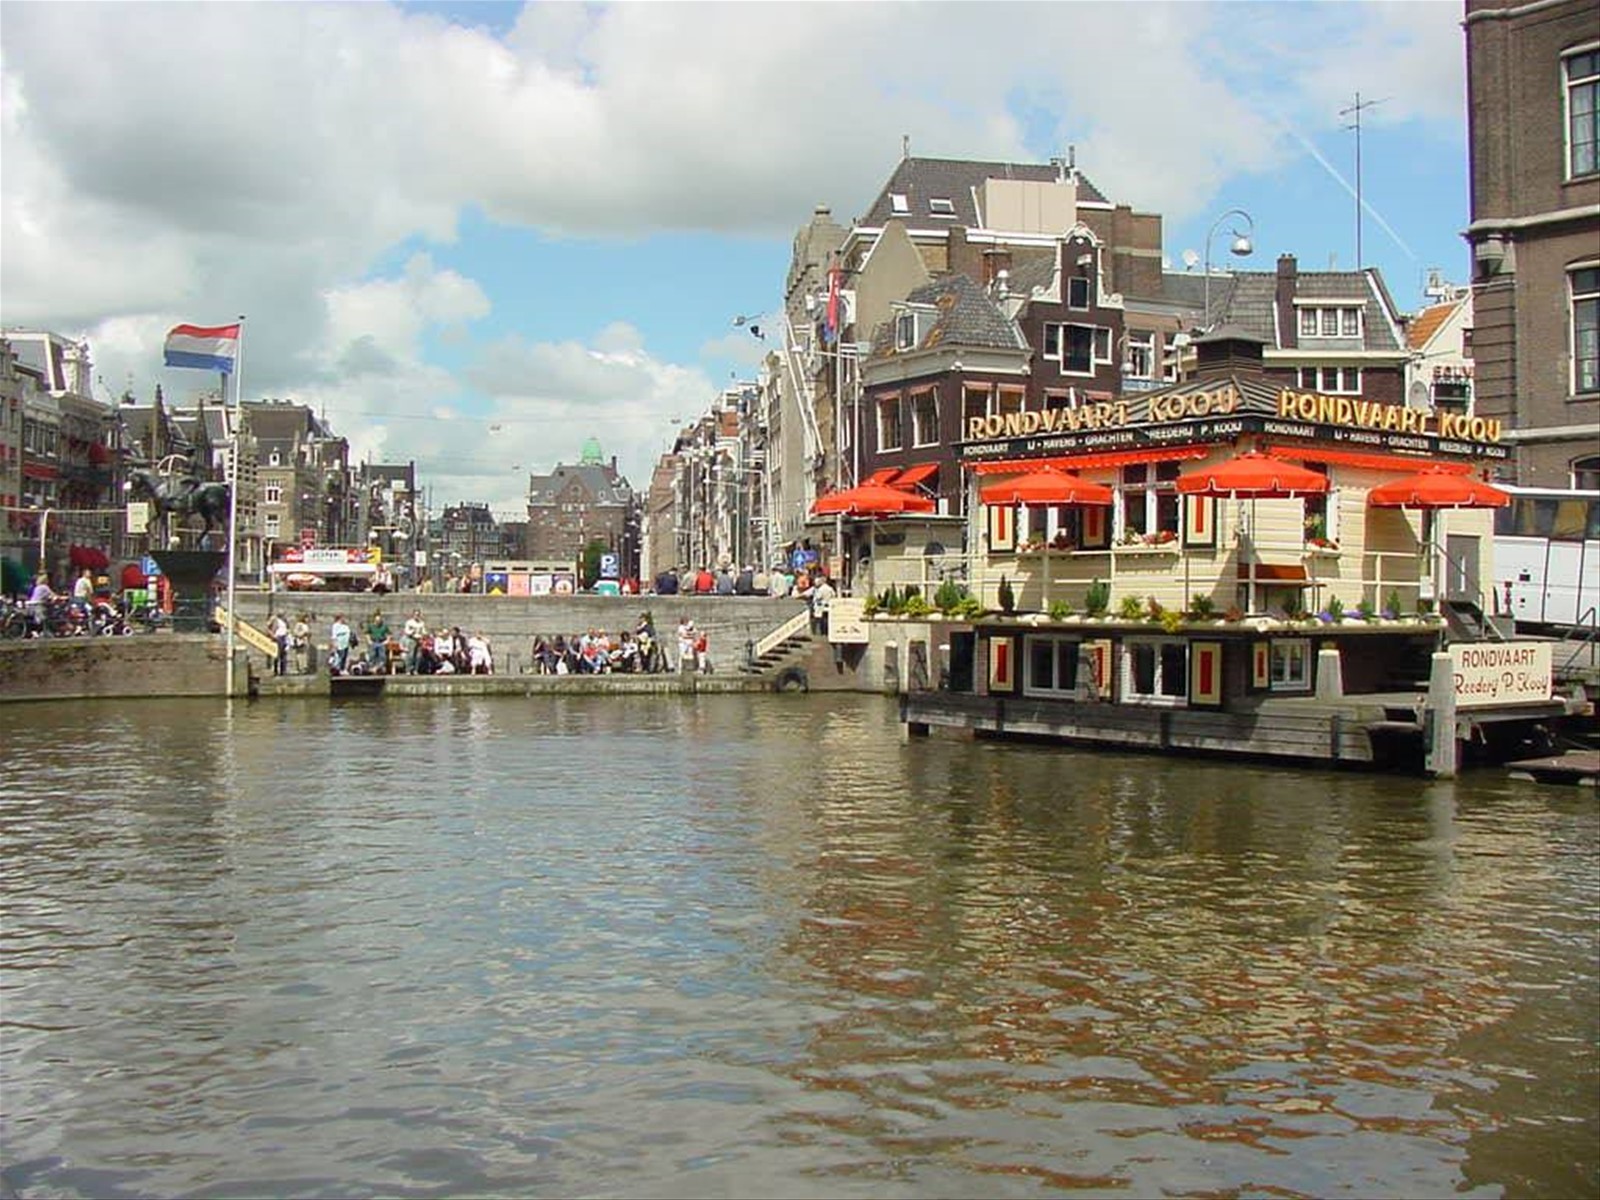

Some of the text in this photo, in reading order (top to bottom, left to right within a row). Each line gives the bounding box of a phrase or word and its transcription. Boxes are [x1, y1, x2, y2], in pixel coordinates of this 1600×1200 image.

[968, 400, 1131, 441] RONDVAART
[1279, 388, 1434, 437] RONDVAART
[1461, 648, 1537, 668] RONDVAART
